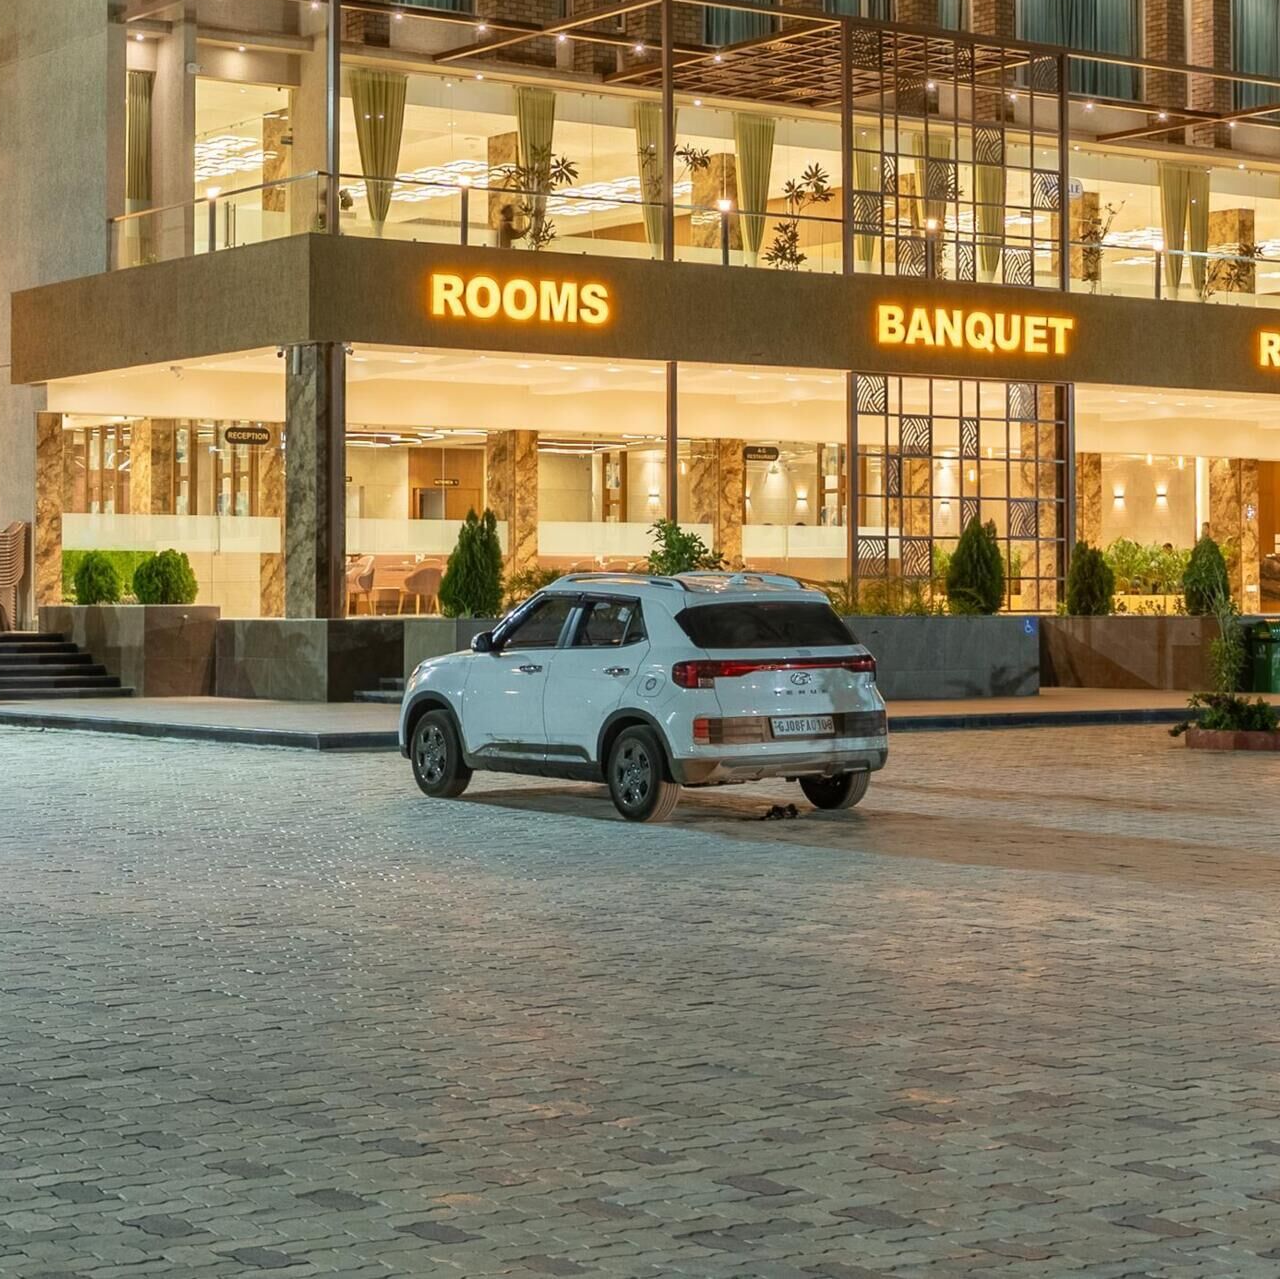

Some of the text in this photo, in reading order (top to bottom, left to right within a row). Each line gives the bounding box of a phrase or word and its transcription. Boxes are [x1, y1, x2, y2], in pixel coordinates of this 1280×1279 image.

[432, 273, 609, 324] ROOMS
[878, 304, 1073, 354] BANQUET
[227, 431, 269, 441] RECEPTION
